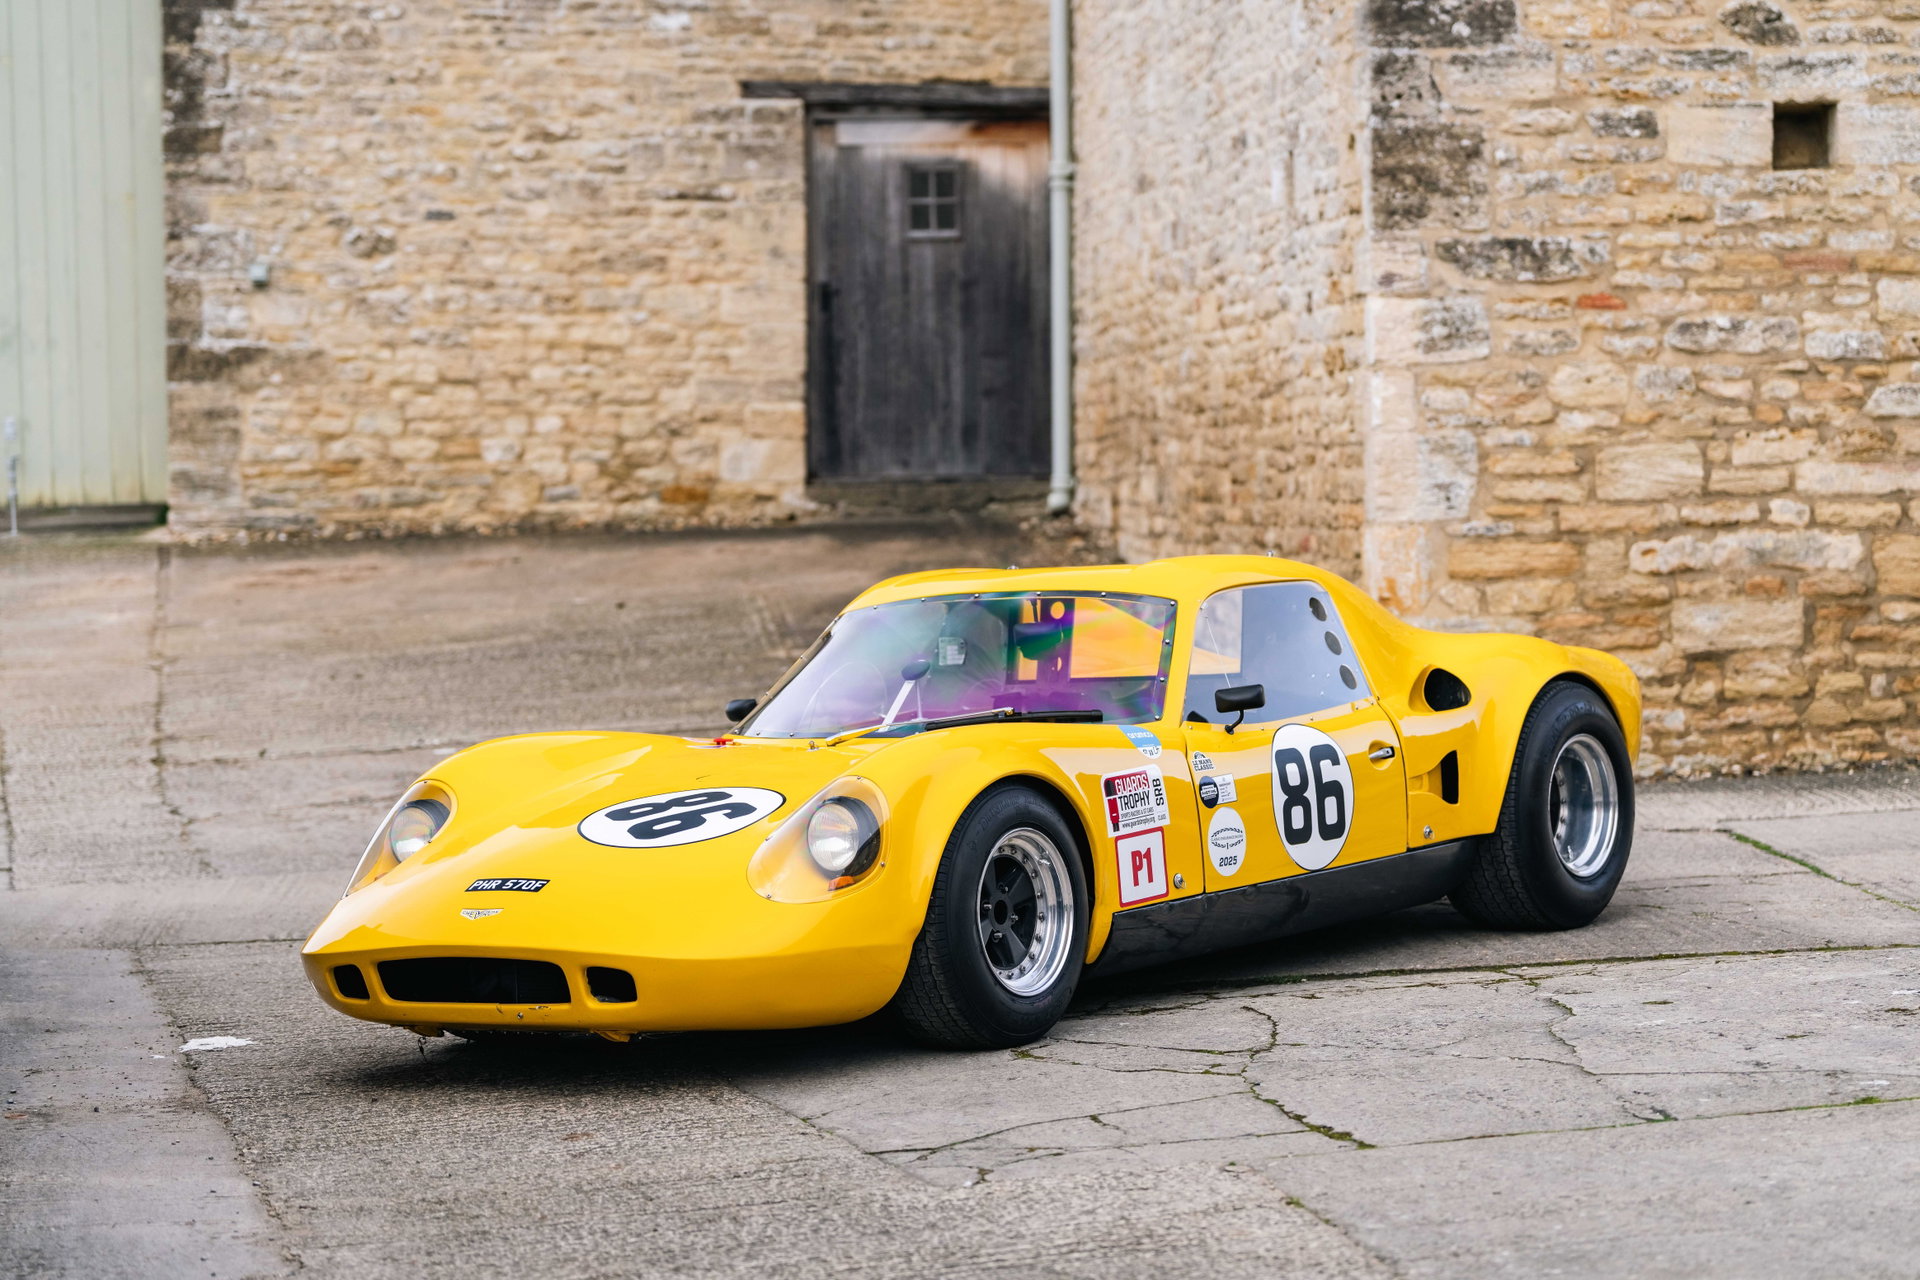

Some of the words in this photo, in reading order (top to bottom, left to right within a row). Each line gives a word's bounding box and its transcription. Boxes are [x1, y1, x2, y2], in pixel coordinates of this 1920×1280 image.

[1194, 763, 1214, 772] CLASSIC
[1114, 773, 1149, 794] GUARDS
[1152, 778, 1165, 806] SRB
[1118, 790, 1150, 811] TROPHY
[1274, 743, 1346, 846] 86
[604, 791, 758, 840] 86
[1131, 847, 1153, 887] P1
[1219, 855, 1238, 867] 2025
[468, 879, 502, 891] PHR
[502, 879, 547, 891] 570F
